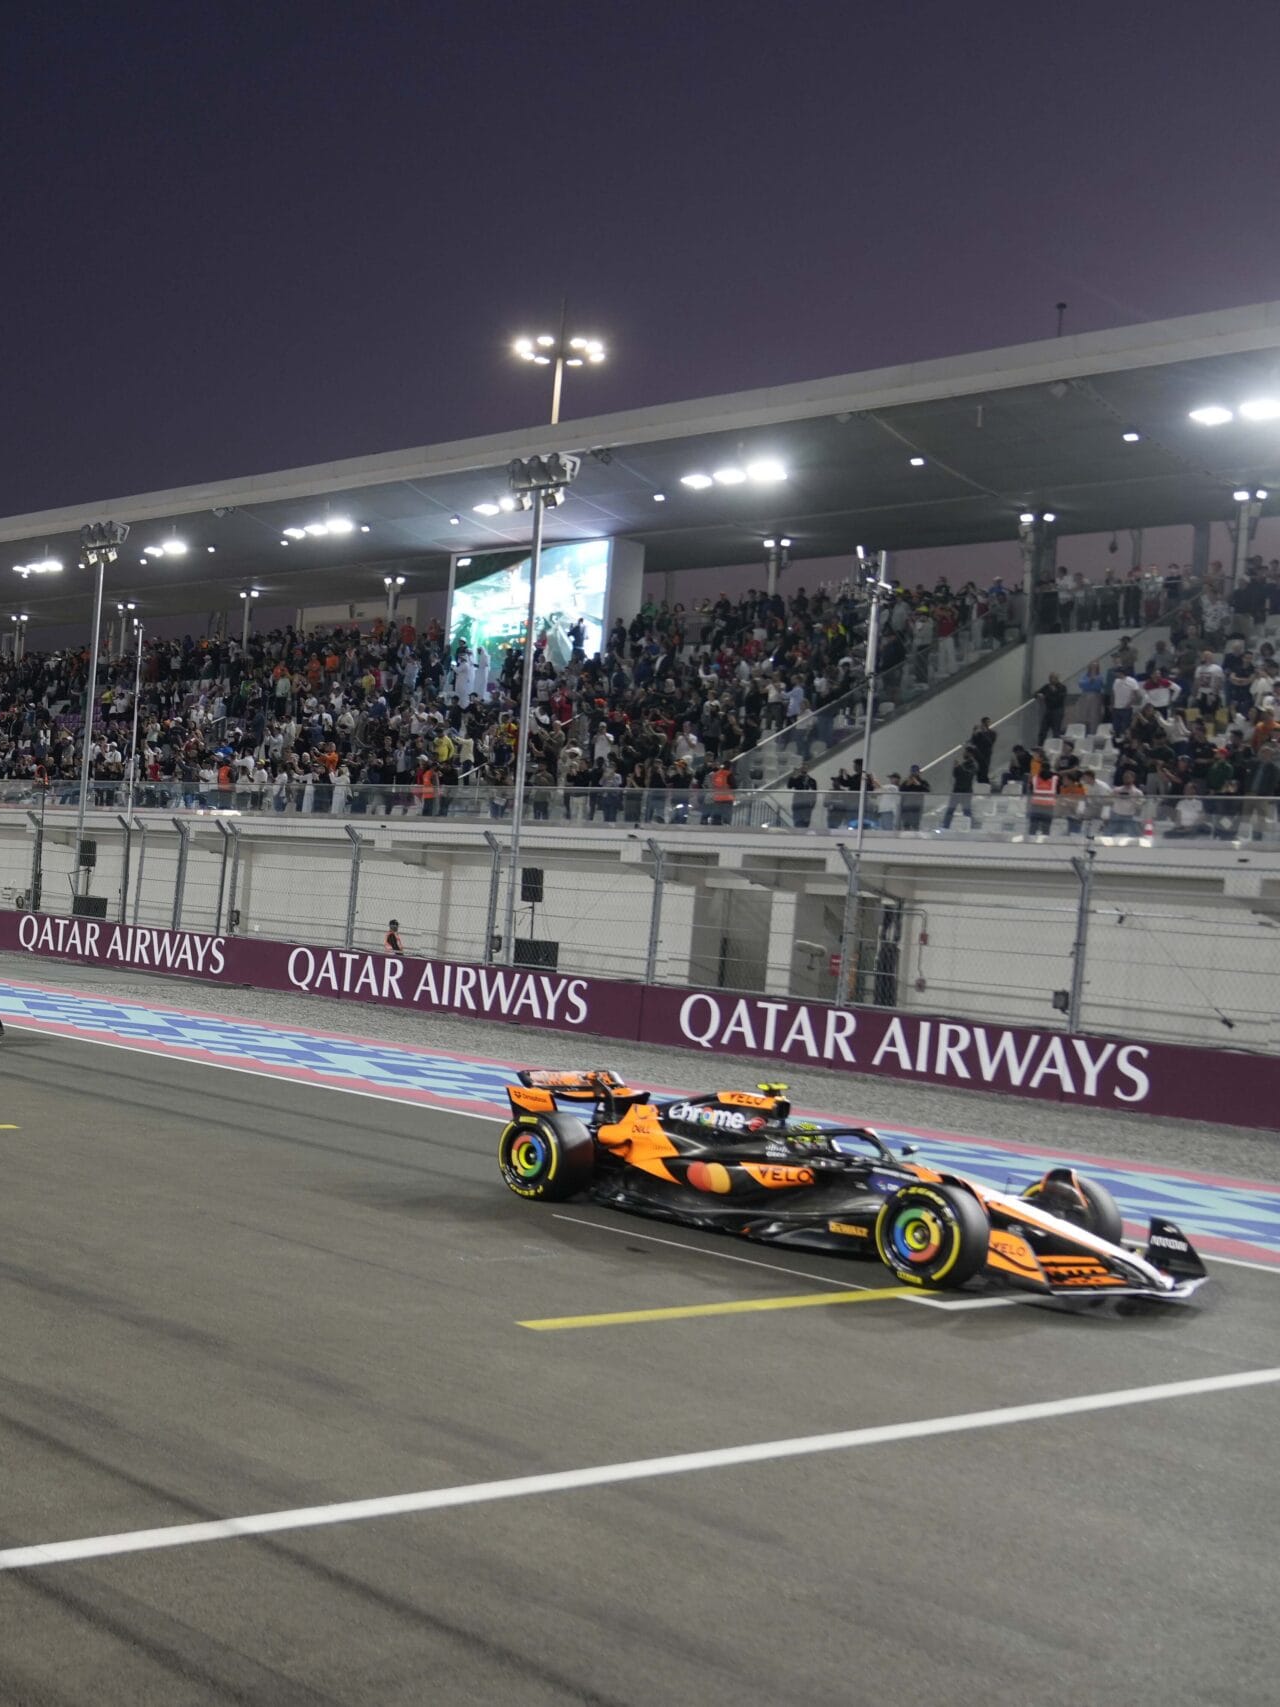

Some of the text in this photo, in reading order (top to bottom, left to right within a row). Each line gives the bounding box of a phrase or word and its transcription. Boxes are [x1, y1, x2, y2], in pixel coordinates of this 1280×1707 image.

[19, 914, 225, 974] QATAR AIRWAYS
[287, 947, 589, 1024] QATAR AIRWAYS
[678, 993, 1150, 1102] QATAR AIRWAYS
[729, 1093, 765, 1105] VELO
[669, 1102, 745, 1129] Chrome
[757, 1165, 814, 1183] VELO
[993, 1242, 1026, 1257] VELO
